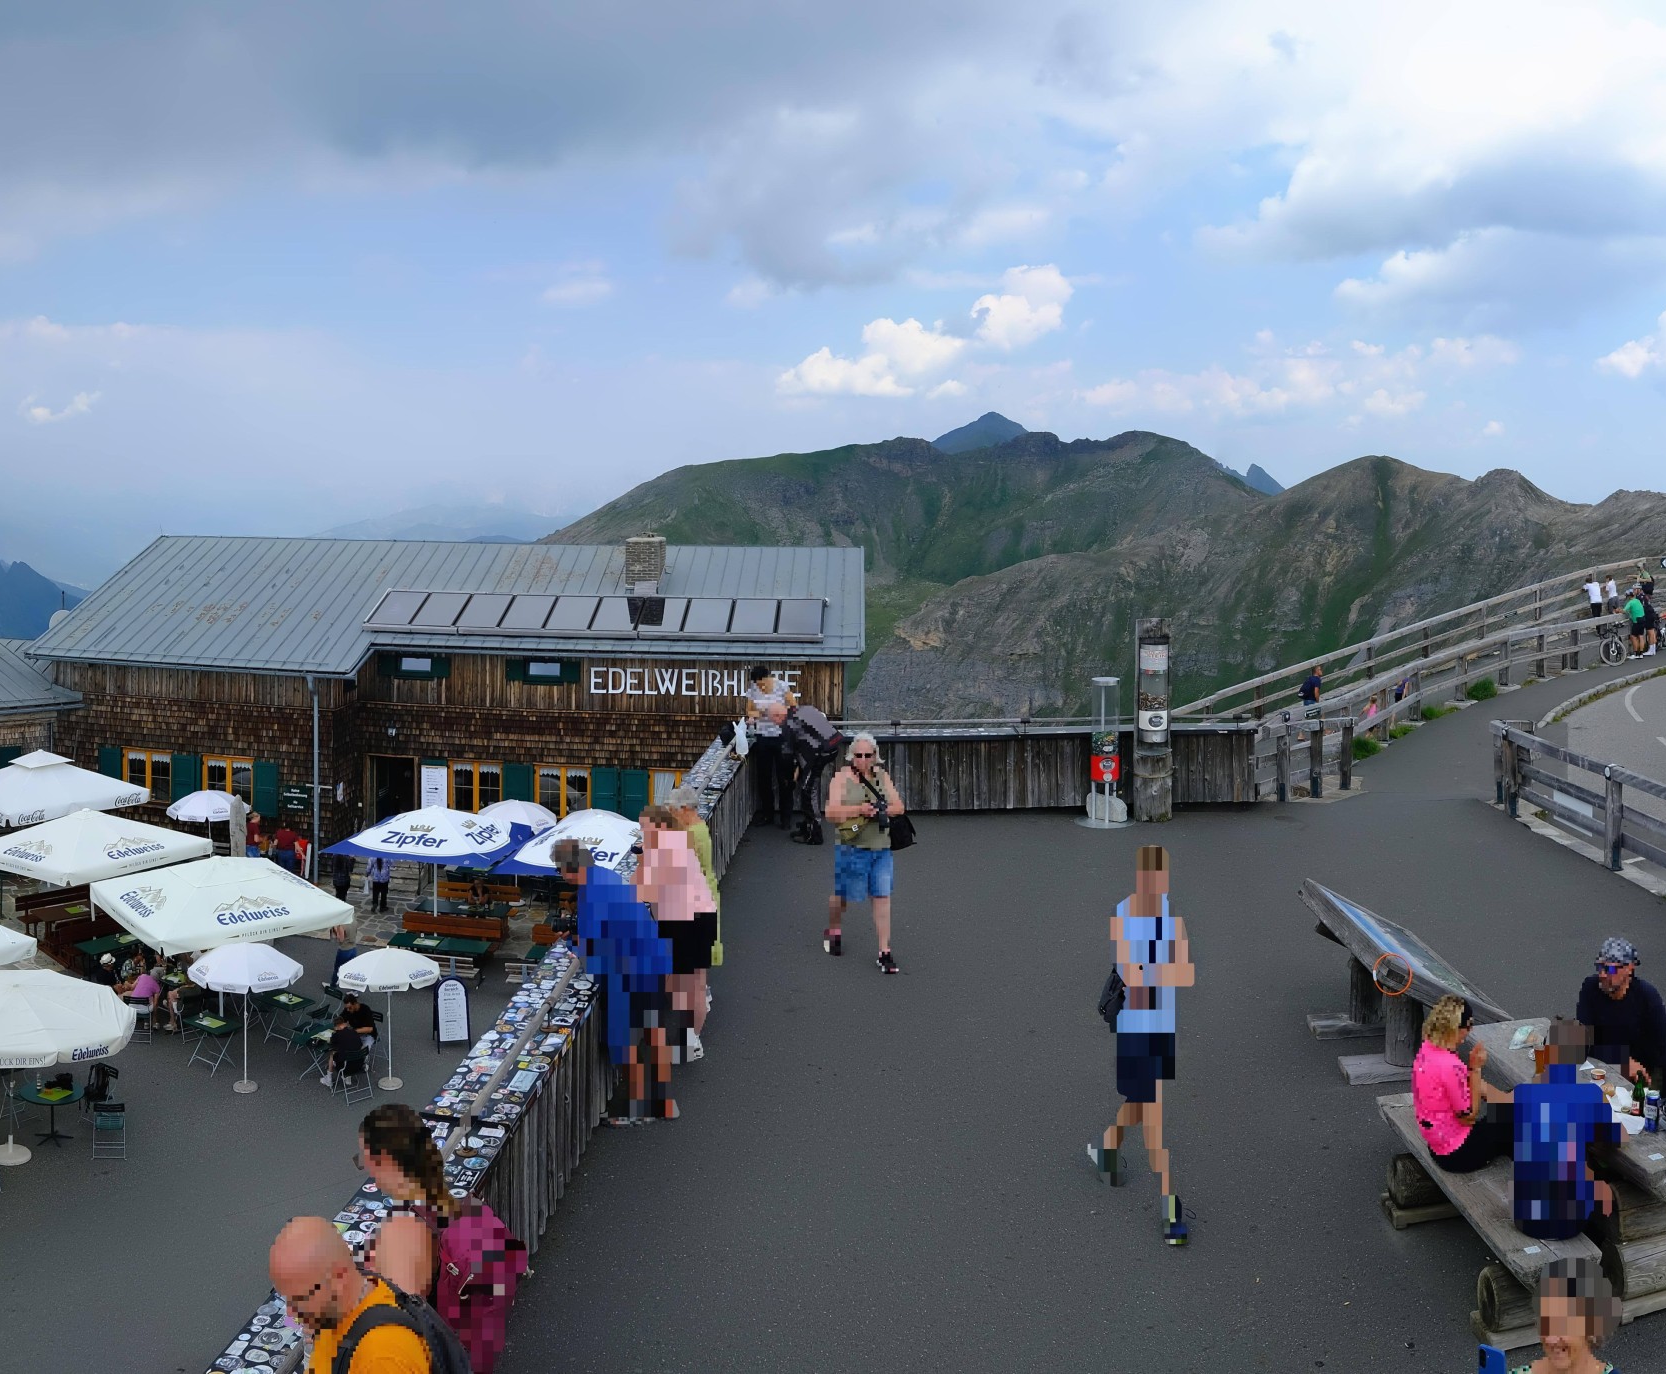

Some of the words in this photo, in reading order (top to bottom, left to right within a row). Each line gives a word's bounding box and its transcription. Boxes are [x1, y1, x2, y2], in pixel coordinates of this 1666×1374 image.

[381, 830, 449, 850] Zipfer
[465, 822, 503, 847] Zipfer
[3, 846, 47, 864] Edelweiss
[107, 843, 165, 860] Edelweiss
[216, 905, 291, 926] Edelweiss
[15, 1057, 27, 1066] DIR
[29, 1056, 46, 1066] EINS!
[71, 1045, 109, 1062] Edelweiss
